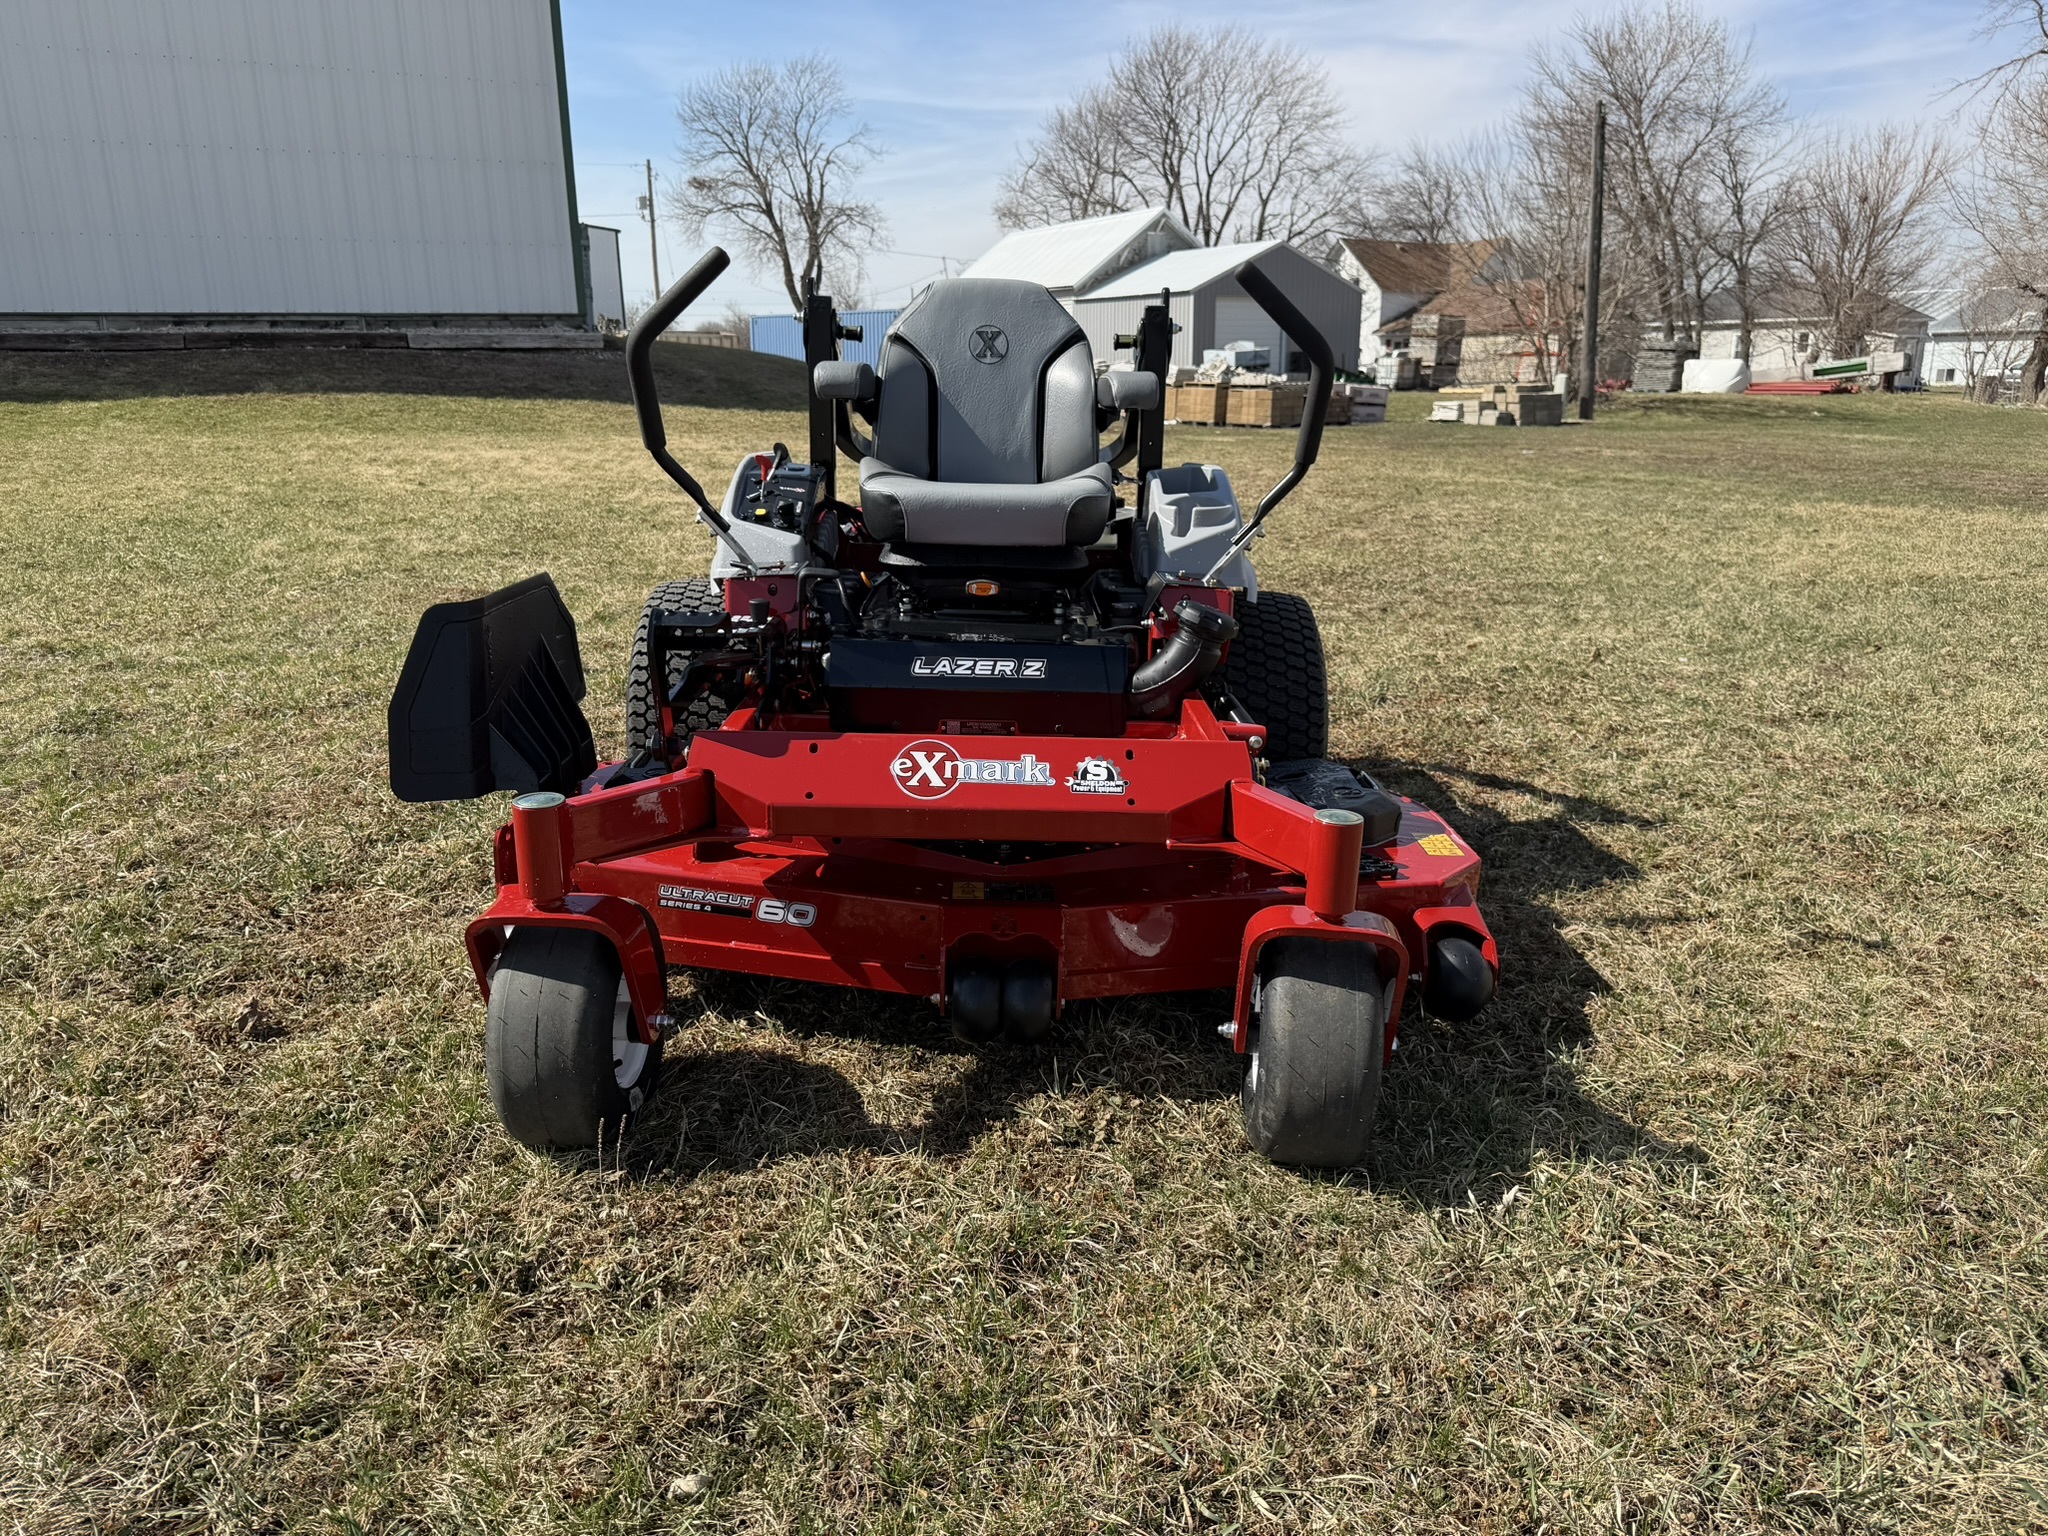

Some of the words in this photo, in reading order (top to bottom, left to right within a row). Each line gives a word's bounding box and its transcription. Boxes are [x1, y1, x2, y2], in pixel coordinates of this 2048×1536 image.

[976, 331, 1003, 358] X
[912, 658, 1016, 676] LAZER
[1021, 660, 1045, 676] Z
[1086, 760, 1108, 781] S
[1095, 785, 1123, 793] Equipment
[659, 899, 701, 911] SERIES
[660, 885, 753, 907] ULTRACUT
[757, 899, 816, 926] 60
